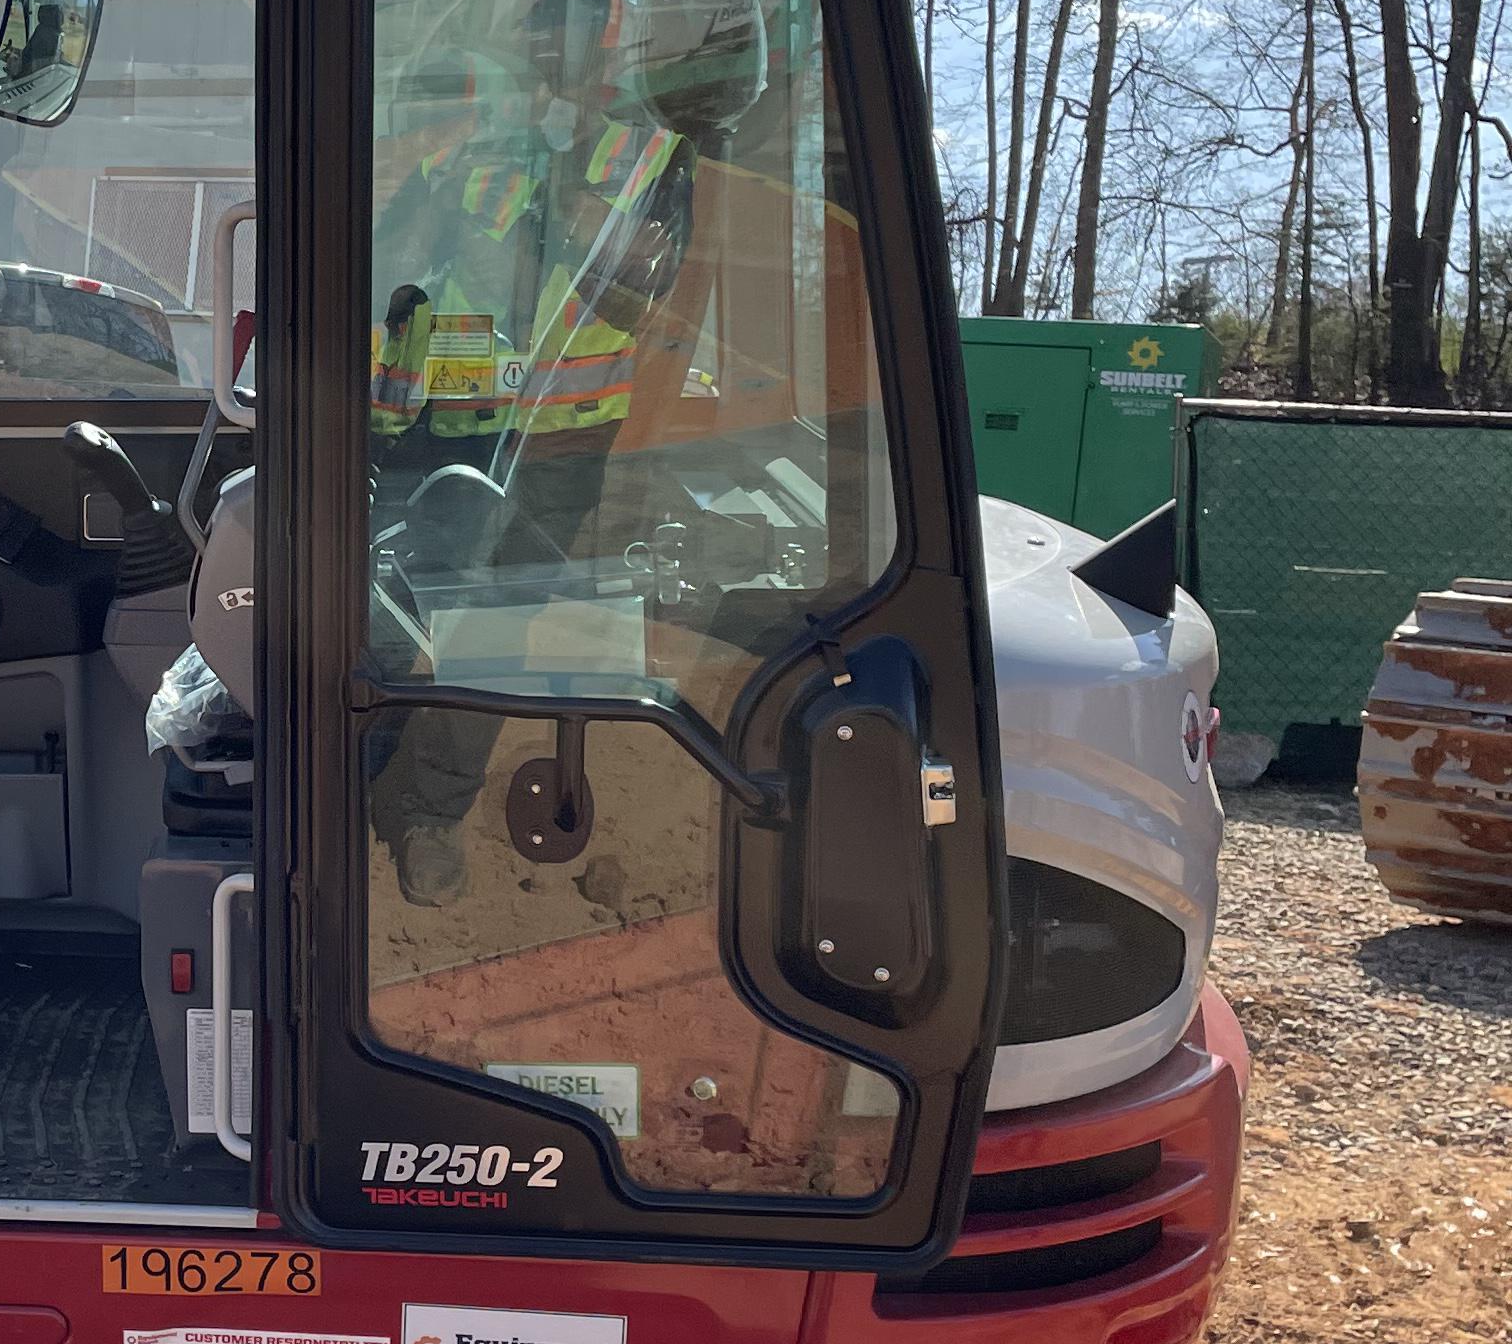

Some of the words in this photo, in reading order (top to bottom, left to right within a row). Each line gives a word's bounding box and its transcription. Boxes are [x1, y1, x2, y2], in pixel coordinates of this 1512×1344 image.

[1100, 370, 1187, 389] SUNBELT
[518, 1073, 604, 1096] DIESEL
[360, 1141, 564, 1188] TB250-2
[109, 1247, 317, 1294] 196278
